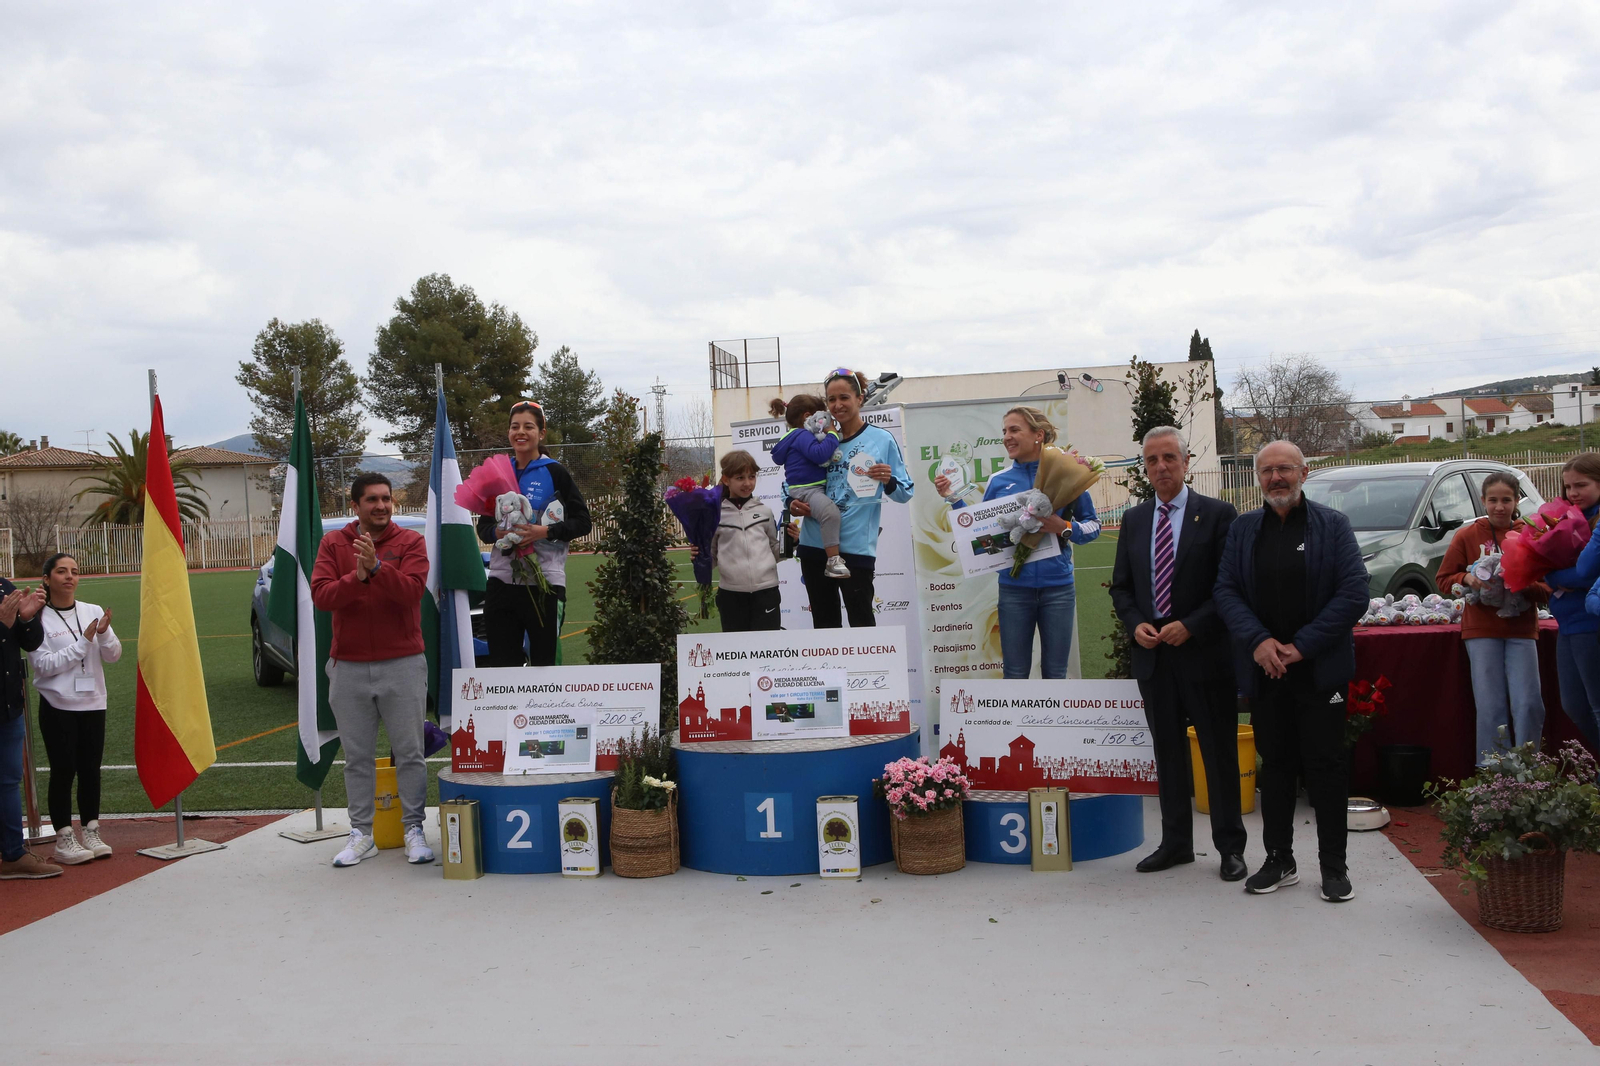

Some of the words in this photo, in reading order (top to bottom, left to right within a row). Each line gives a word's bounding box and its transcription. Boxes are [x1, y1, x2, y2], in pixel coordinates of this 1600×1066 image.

[738, 426, 780, 438] SERVICIO
[974, 436, 1004, 448] flores
[920, 446, 941, 460] EL
[974, 508, 990, 516] MEDIA
[990, 501, 1017, 512] MARATÓN
[974, 512, 996, 521] CIUDAD
[929, 582, 956, 592] Bodas
[931, 602, 963, 612] Eventos
[932, 622, 973, 633] Jardinería
[47, 630, 68, 639] Calvin
[715, 651, 747, 660] MEDIA
[750, 647, 799, 659] MARATÓN
[801, 647, 840, 657] CIUDAD
[842, 646, 855, 656] DE
[857, 645, 896, 655] LUCENA
[933, 643, 976, 655] Paisajismo
[934, 662, 970, 675] Entregas
[486, 685, 515, 694] MEDIA
[517, 682, 562, 693] MARATÓN
[565, 684, 600, 692] CIUDAD
[602, 683, 615, 692] DE
[617, 682, 654, 691] LUCENA
[872, 676, 887, 688] €
[525, 698, 576, 709] Doscientos
[577, 697, 604, 708] Euros
[978, 699, 1008, 708] MEDIA
[1011, 697, 1060, 709] MARATÓN
[1063, 699, 1102, 709] CIUDAD
[1104, 700, 1117, 708] DE
[1120, 700, 1145, 708] LUCE
[599, 713, 625, 724] 200
[630, 711, 643, 724] €
[1021, 714, 1054, 726] Ciento
[1056, 715, 1109, 726] Cincuenta
[1111, 715, 1141, 726] Euros
[1101, 732, 1126, 745] 150
[1130, 732, 1145, 745] €
[756, 798, 782, 838] 1
[506, 809, 532, 849] 2
[1000, 812, 1026, 854] 3
